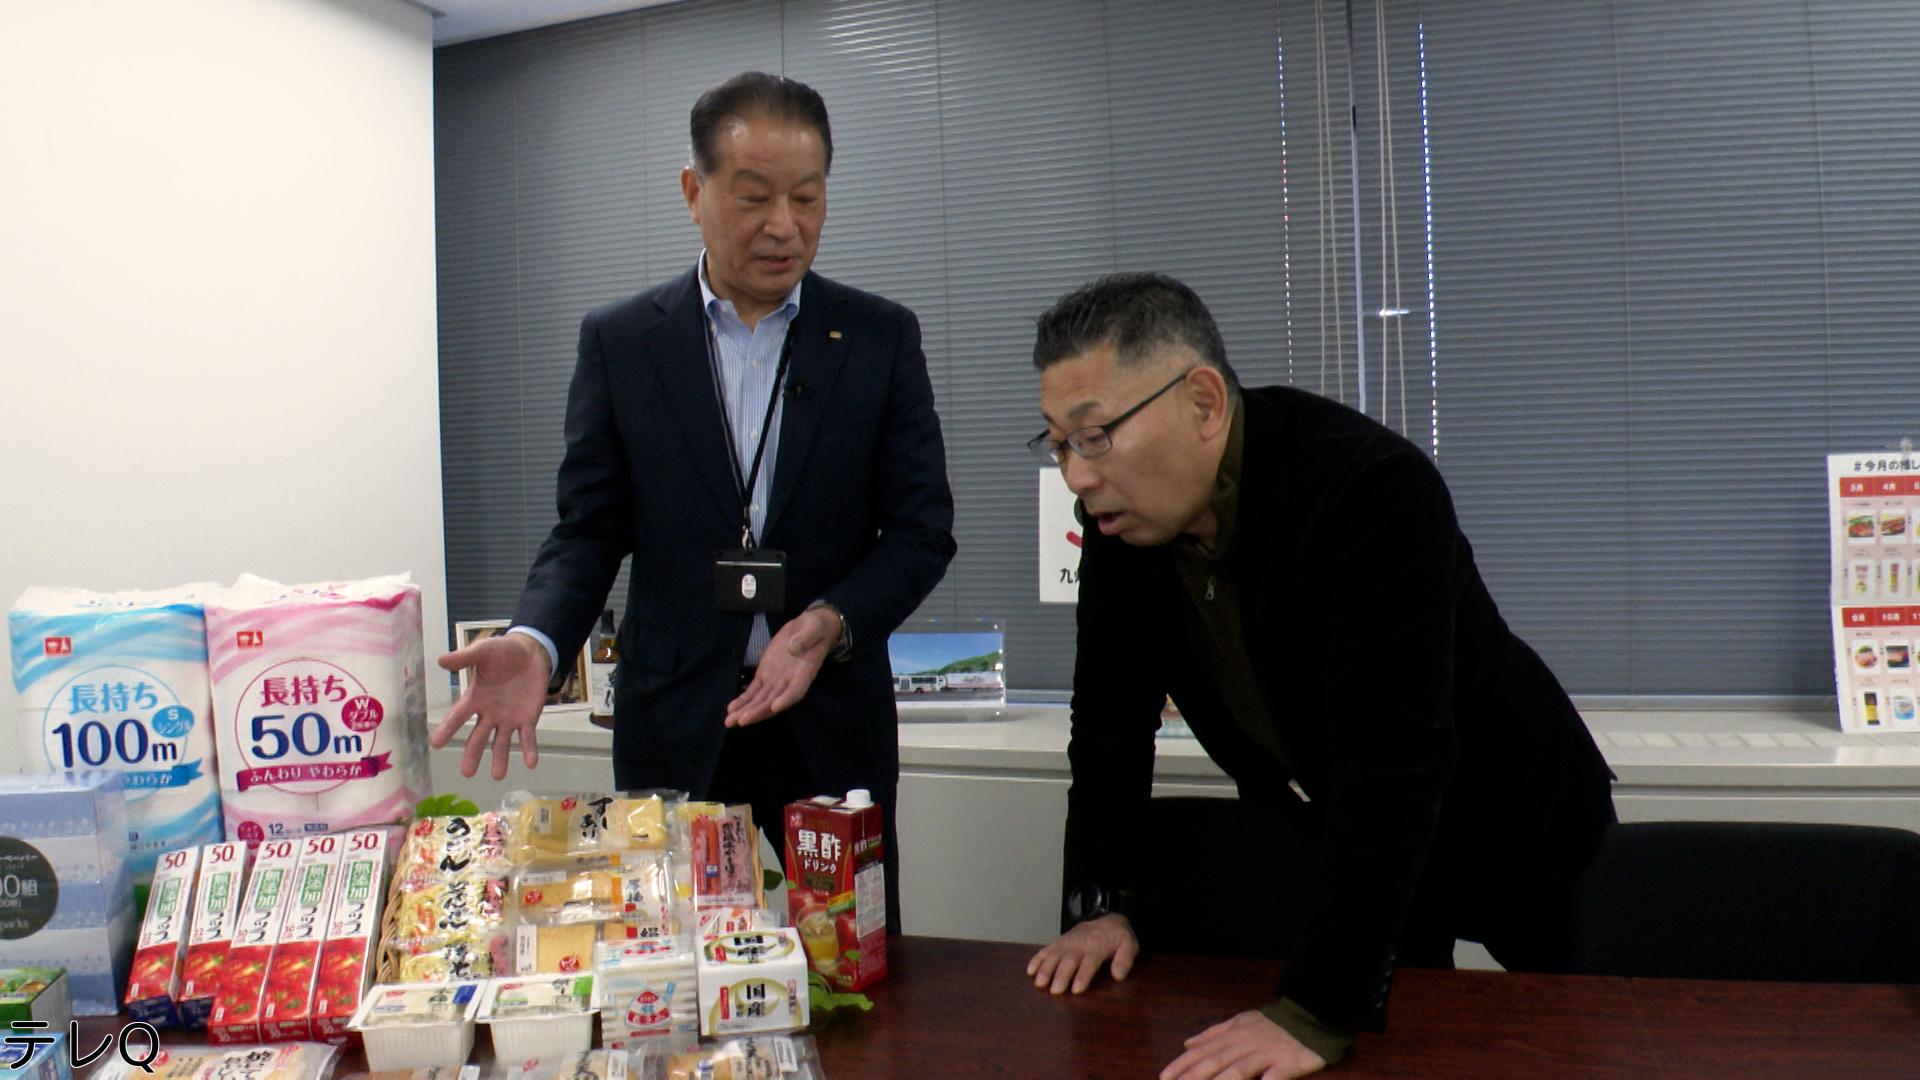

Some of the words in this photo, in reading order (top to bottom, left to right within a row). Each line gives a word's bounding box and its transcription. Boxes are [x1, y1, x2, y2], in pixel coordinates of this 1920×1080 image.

[68, 681, 159, 715] 長持ち
[260, 674, 348, 708] 長持ち
[354, 697, 370, 710] W
[167, 708, 179, 720] S
[250, 766, 301, 783] ふんわり
[309, 763, 362, 778] やわらか
[268, 823, 283, 835] 12
[262, 841, 292, 860] 50
[305, 837, 335, 856] 50
[351, 832, 379, 852] 50
[797, 829, 841, 862] 黒酢
[164, 850, 187, 870] 50
[208, 845, 234, 864] 50
[804, 858, 837, 875] ドリンク
